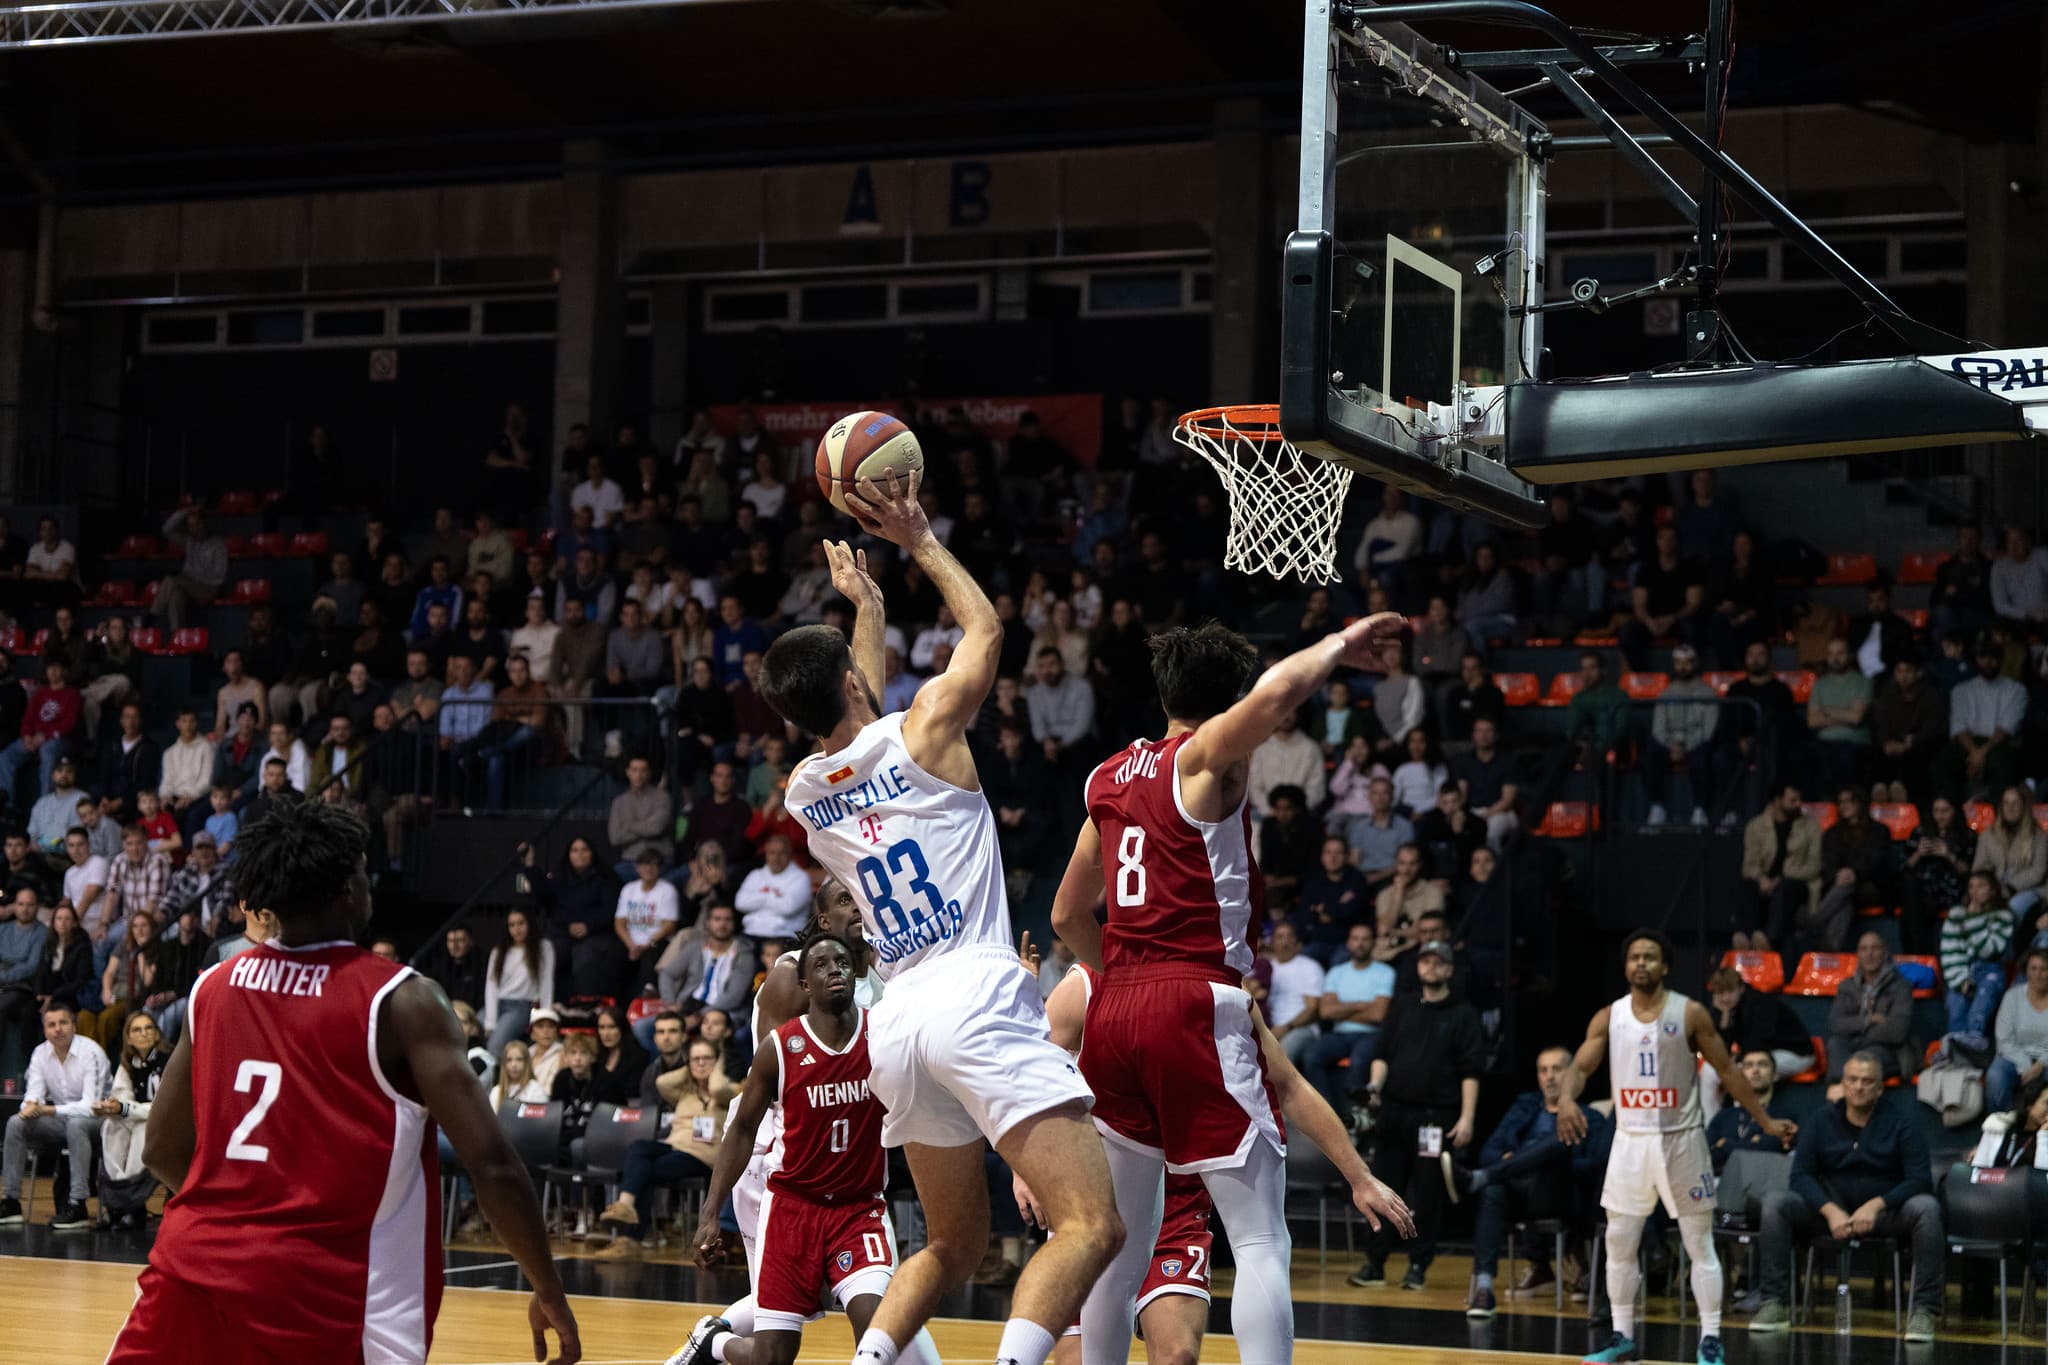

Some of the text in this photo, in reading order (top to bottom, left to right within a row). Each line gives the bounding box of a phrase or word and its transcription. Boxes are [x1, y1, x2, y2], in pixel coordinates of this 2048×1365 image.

[843, 165, 880, 223] A
[951, 161, 991, 226] B
[766, 405, 830, 431] mehr
[802, 765, 911, 832] BOUTEILLE
[1117, 826, 1146, 907] 8
[856, 838, 947, 941] 83
[229, 956, 330, 997] HUNTER
[1640, 1053, 1656, 1076] 11
[225, 1059, 282, 1162] 2
[806, 1079, 870, 1108] VIENNA
[1623, 1090, 1673, 1107] VOLI
[831, 1119, 849, 1153] 0
[863, 1233, 885, 1262] 0
